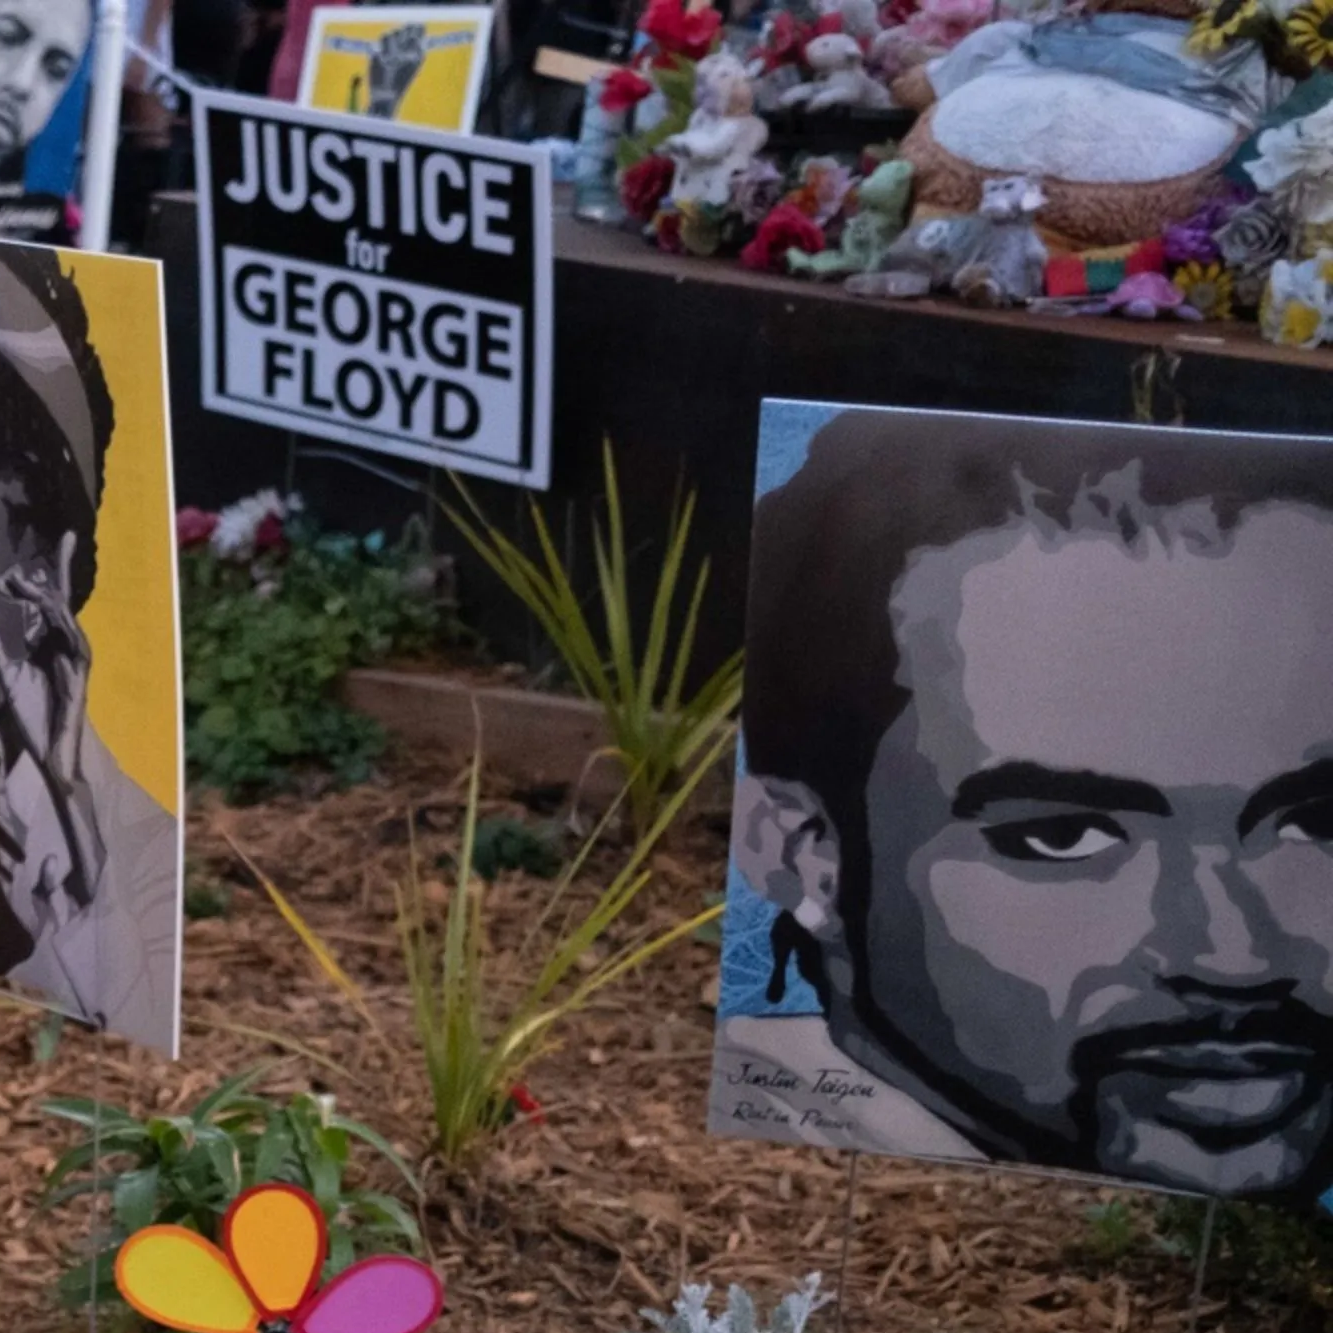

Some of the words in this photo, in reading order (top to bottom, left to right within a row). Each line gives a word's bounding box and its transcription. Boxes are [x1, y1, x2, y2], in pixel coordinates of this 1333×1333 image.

[224, 119, 515, 255] JUSTICE
[344, 227, 392, 273] for
[235, 262, 513, 382] GEORGE
[263, 340, 480, 441] FLOYD
[726, 1063, 799, 1091] Justin
